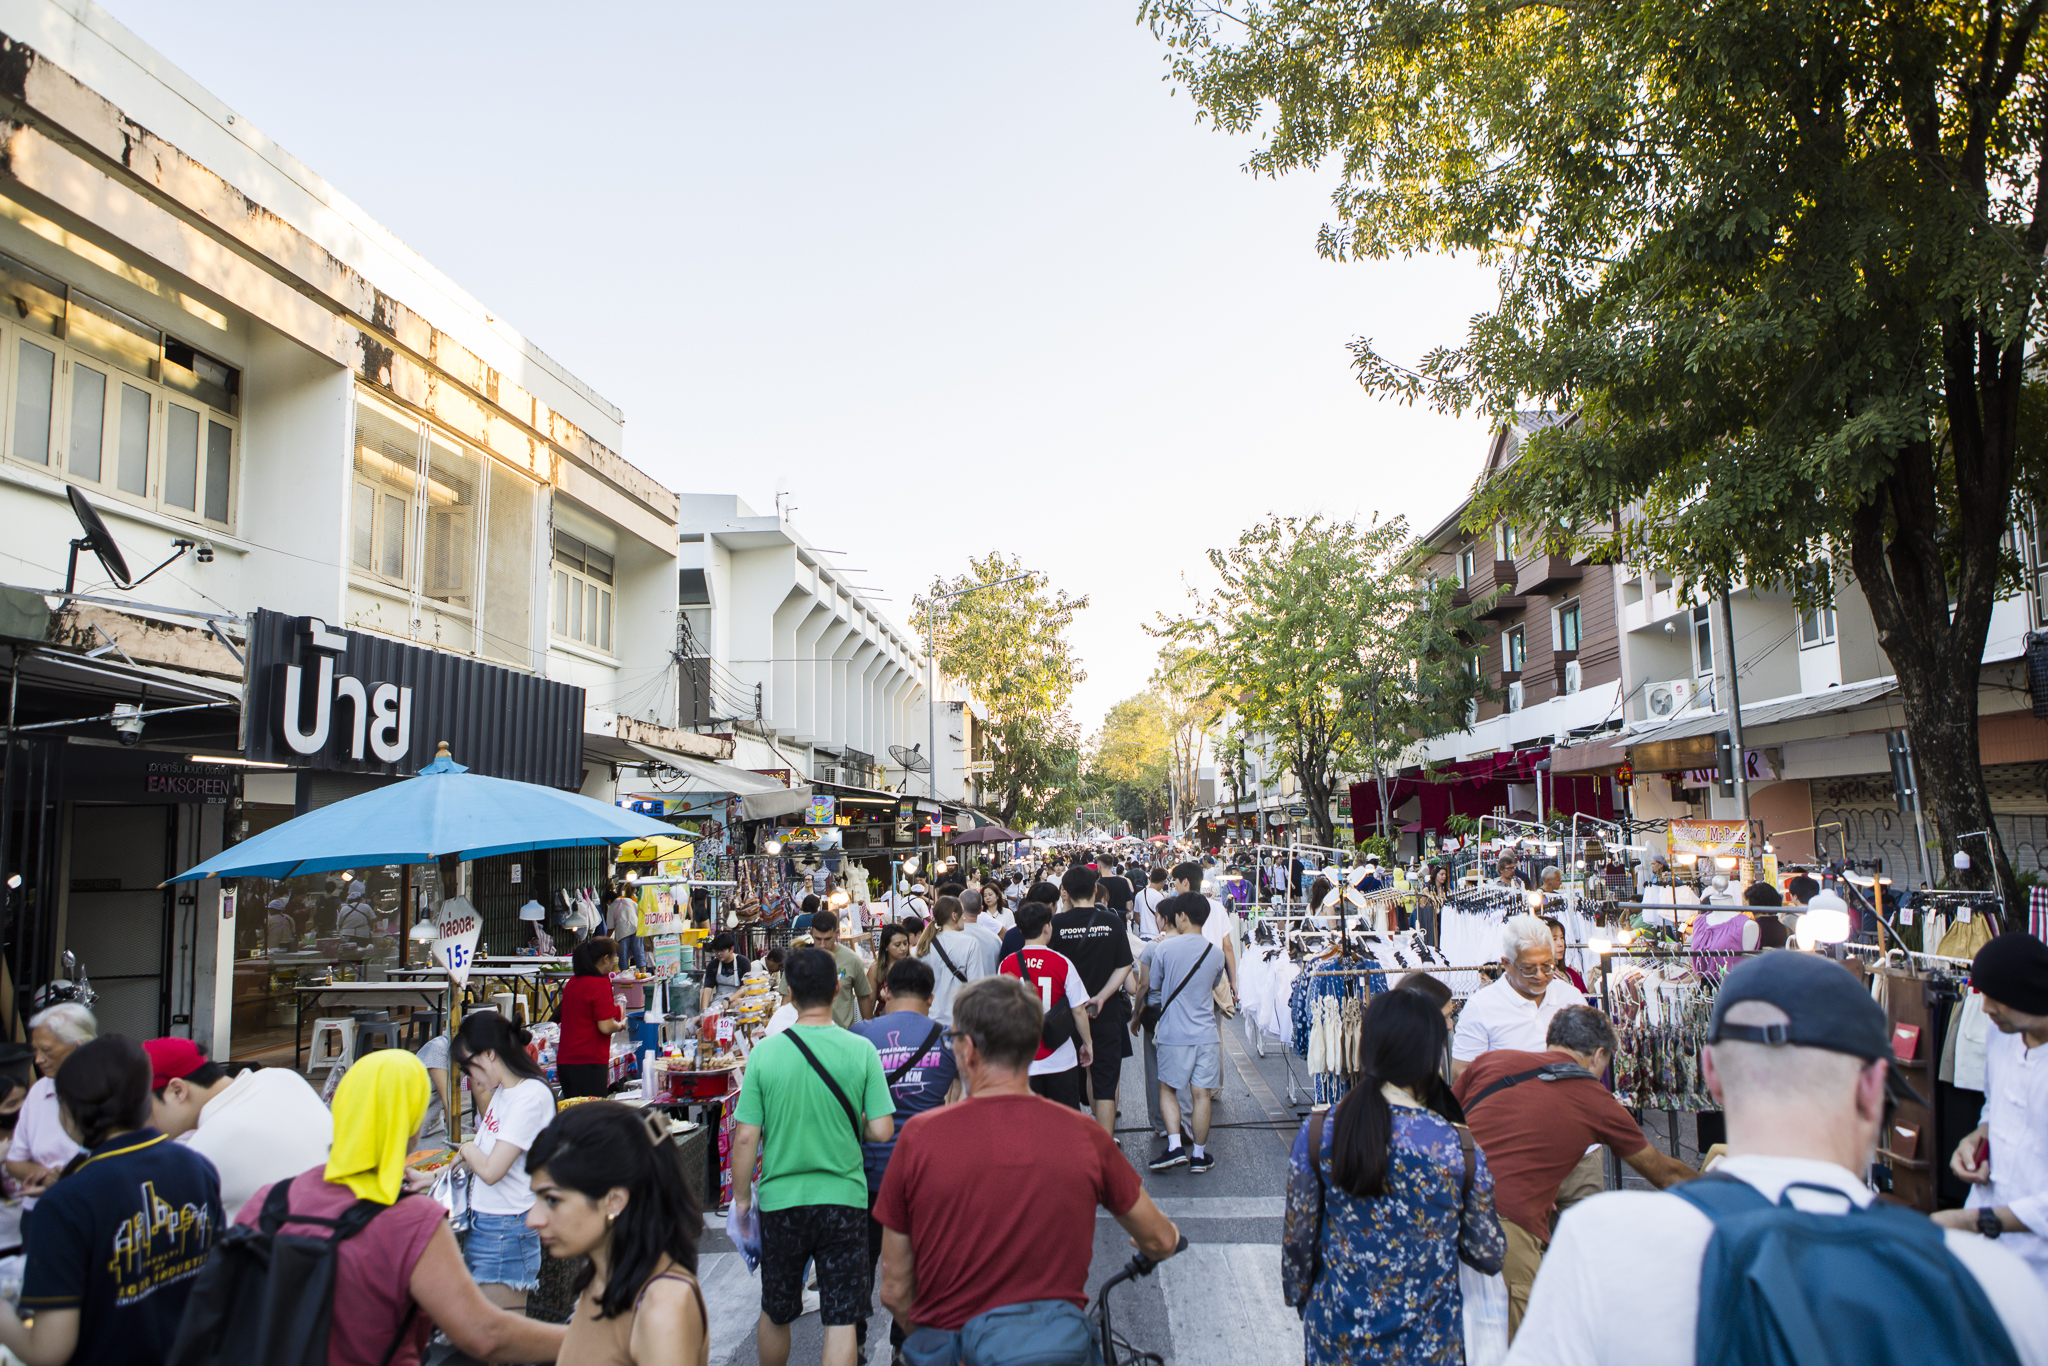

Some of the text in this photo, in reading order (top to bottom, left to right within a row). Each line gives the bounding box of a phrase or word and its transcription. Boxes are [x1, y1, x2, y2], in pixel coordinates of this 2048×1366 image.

[283, 617, 412, 763] ป้าย
[147, 776, 229, 795] EAKSCREEN
[439, 911, 475, 940] กล่องละ
[1025, 958, 1043, 969] ICE
